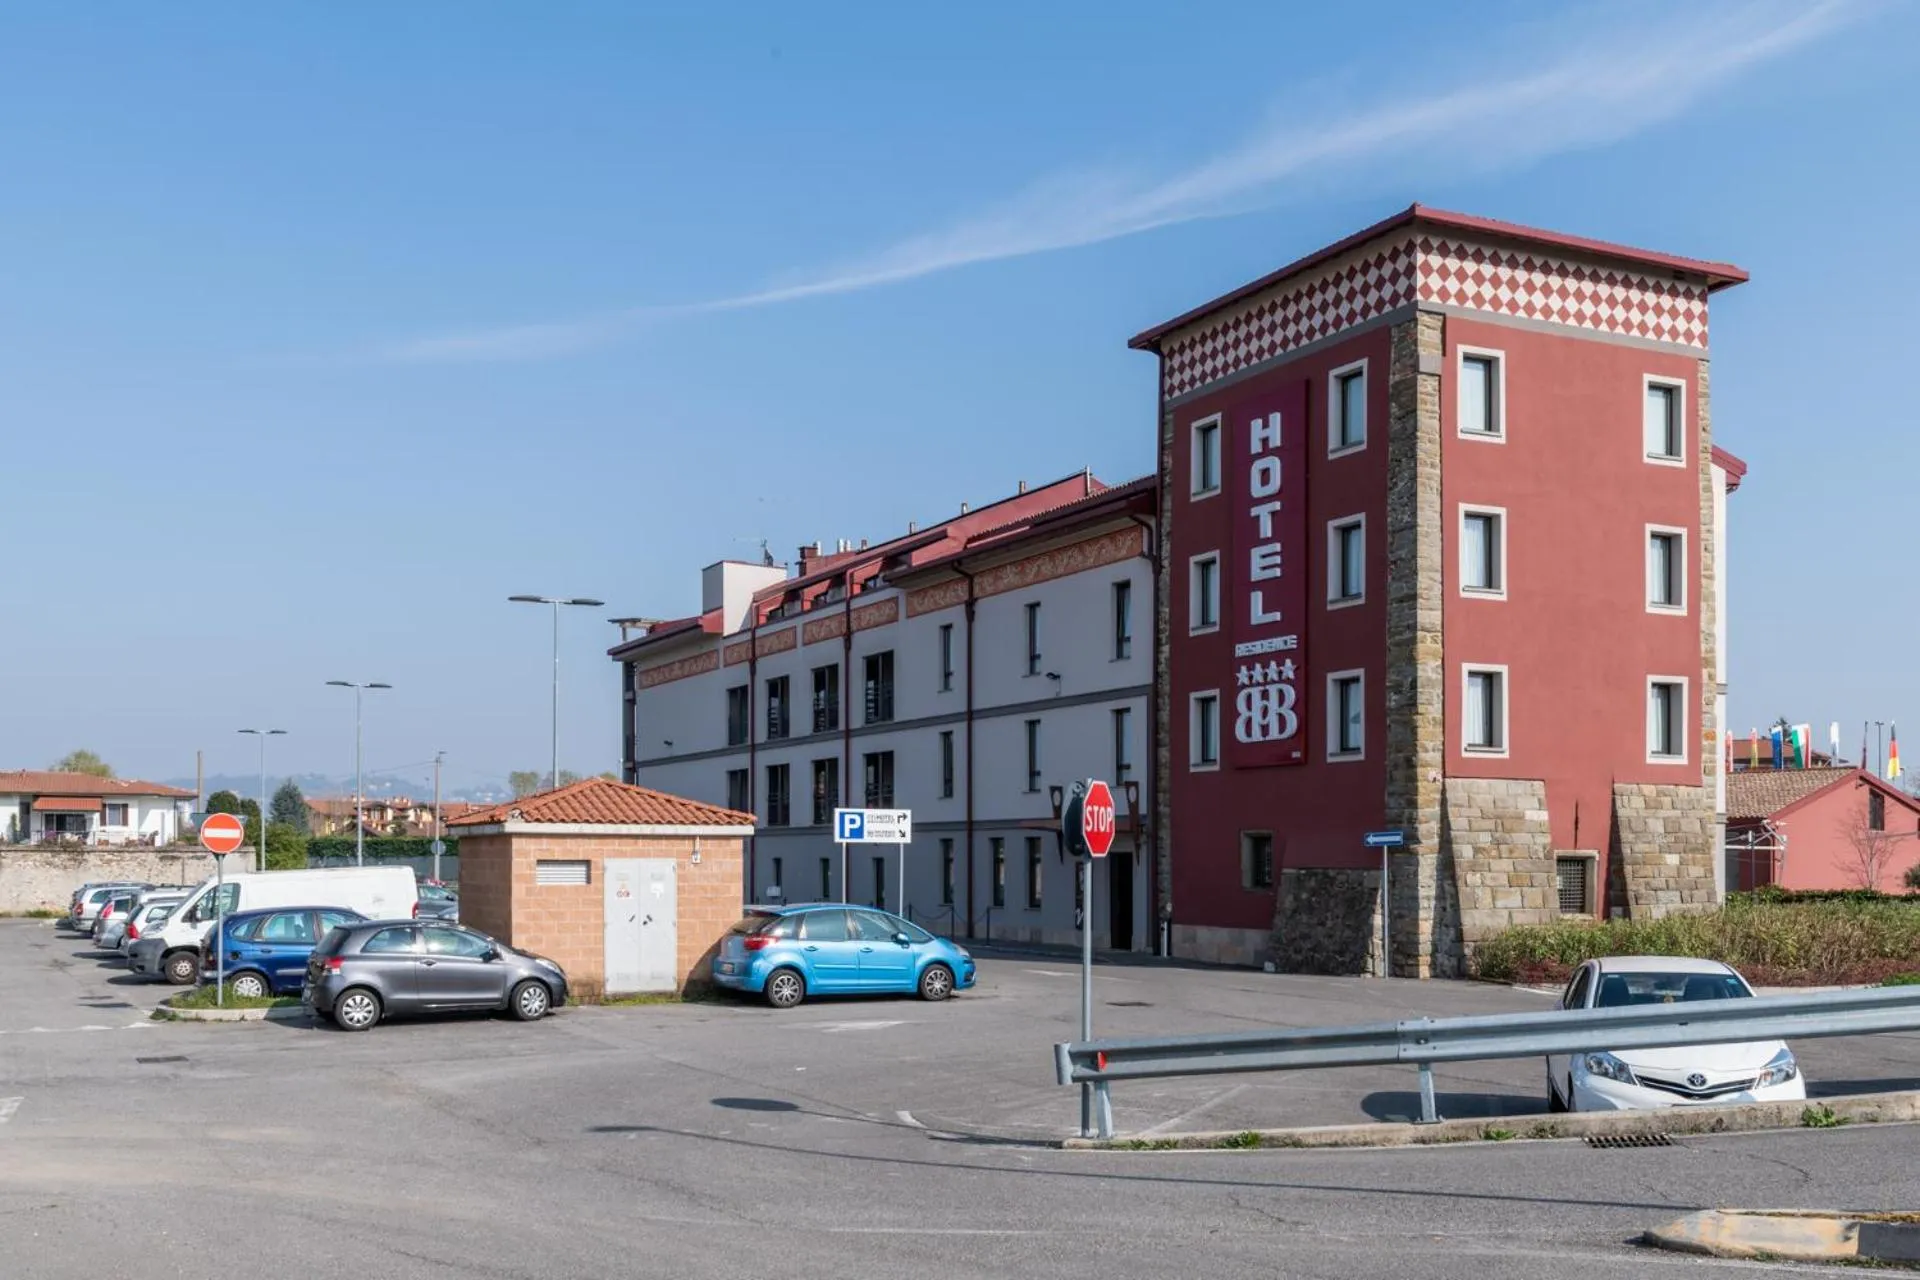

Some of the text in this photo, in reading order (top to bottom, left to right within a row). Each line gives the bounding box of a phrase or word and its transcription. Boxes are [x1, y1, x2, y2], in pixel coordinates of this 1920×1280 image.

[1250, 411, 1282, 626] HOTEL
[844, 813, 861, 838] P
[1085, 805, 1113, 833] STOP
